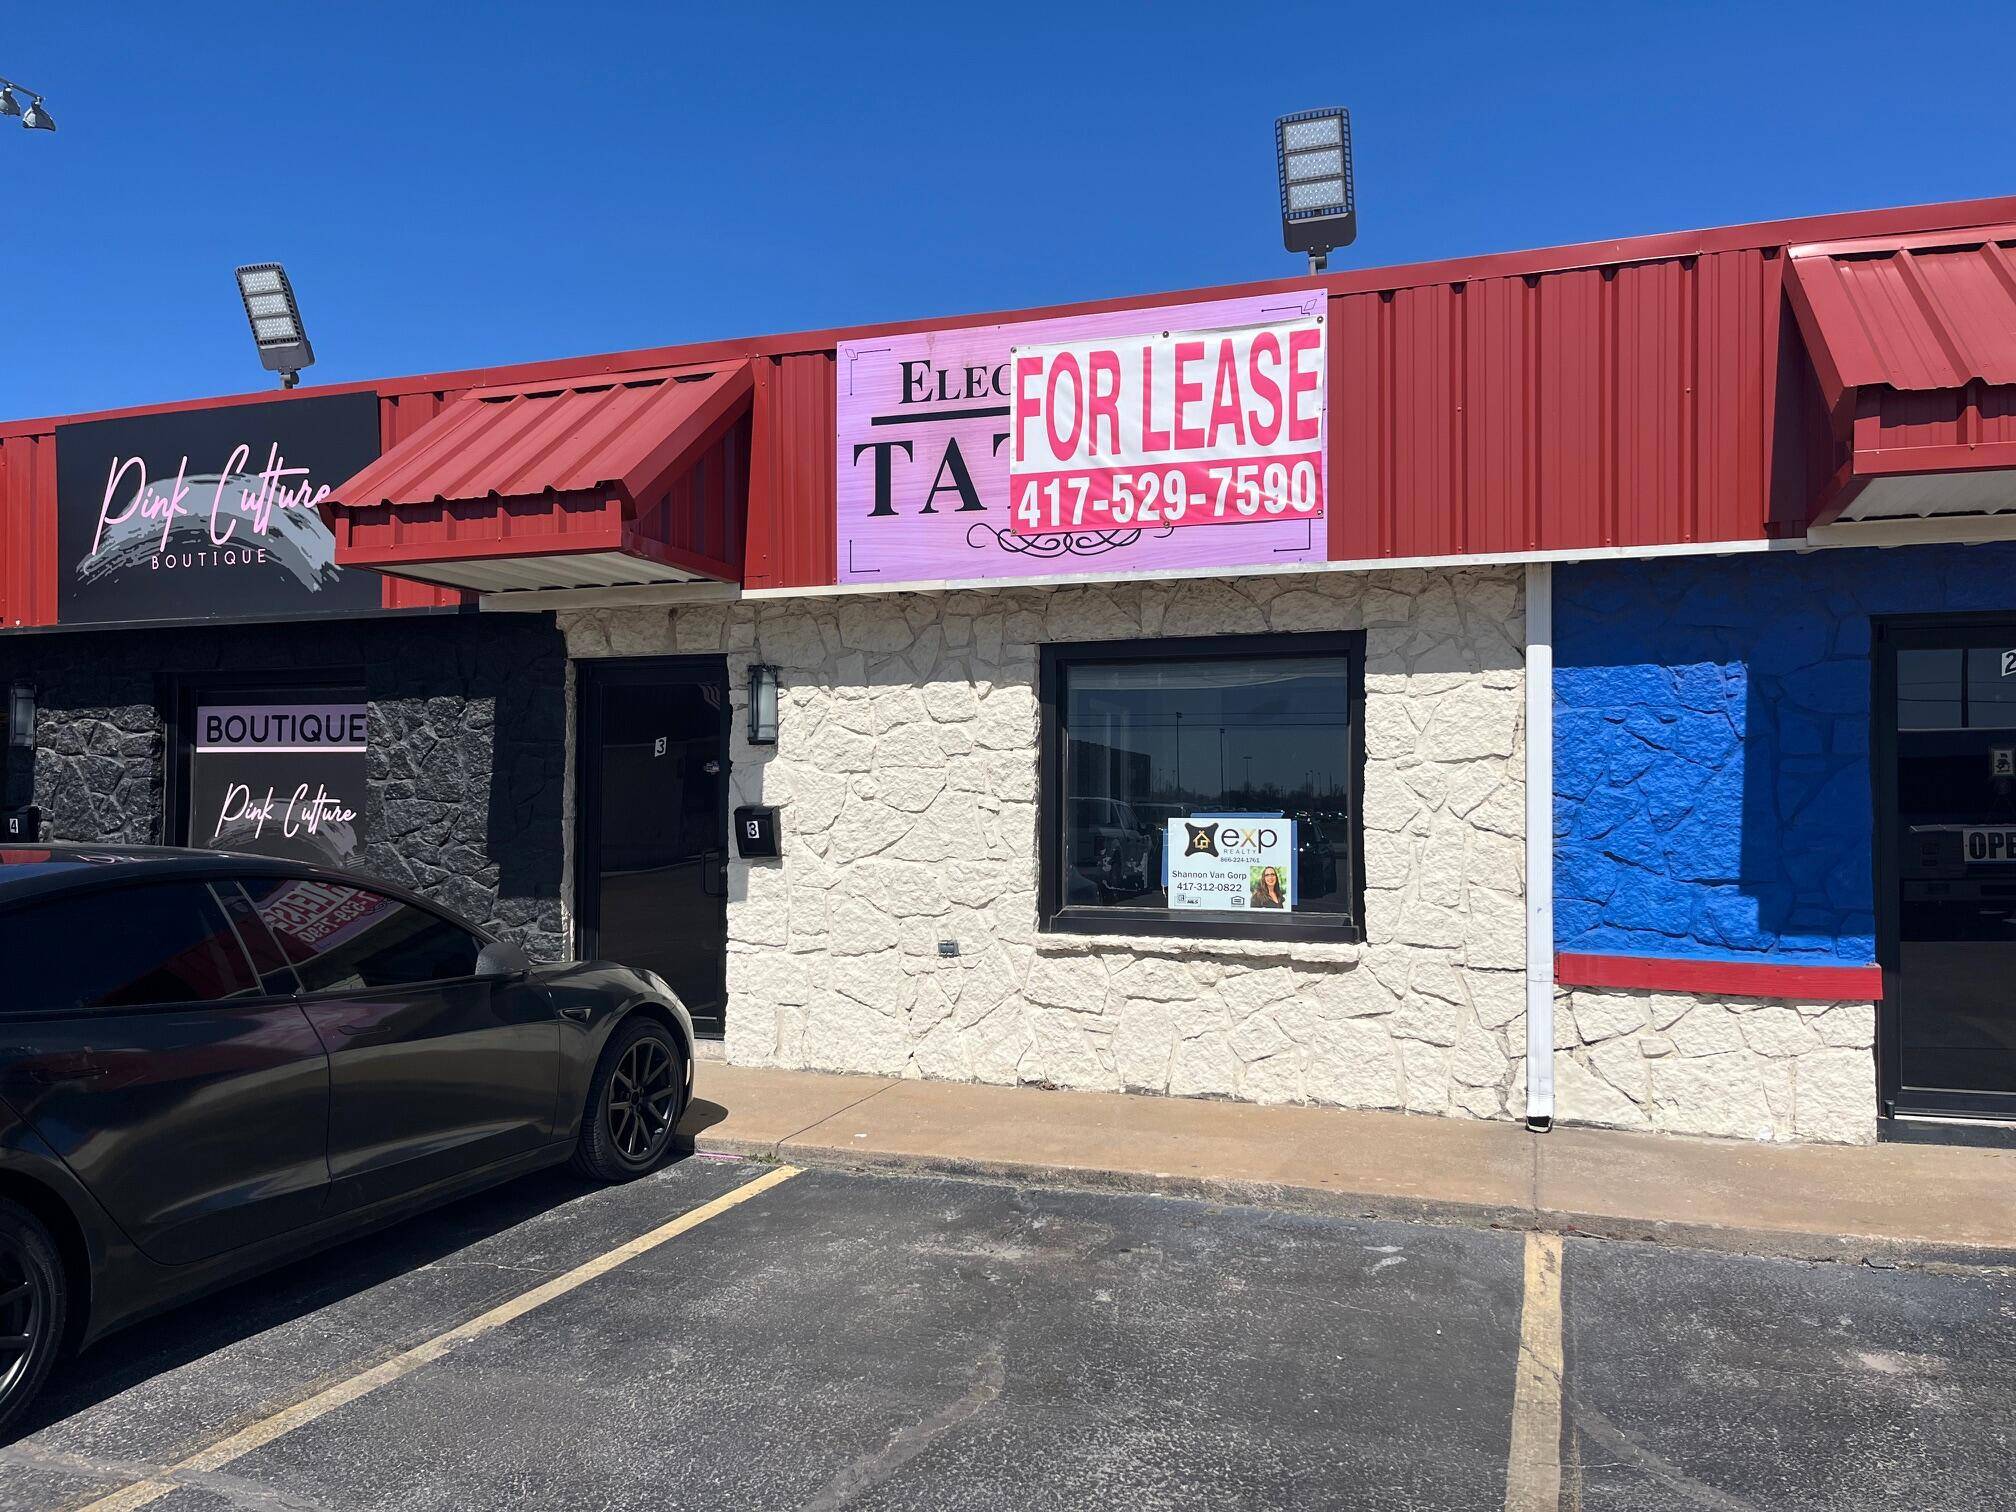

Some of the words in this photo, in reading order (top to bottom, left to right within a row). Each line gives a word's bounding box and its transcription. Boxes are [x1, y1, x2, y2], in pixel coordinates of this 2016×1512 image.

[1016, 349, 1122, 462] FOR
[1142, 328, 1322, 452] LEASE
[91, 455, 190, 556] Pink
[209, 441, 332, 546] Culture
[1017, 460, 1316, 529] 417-529-7590
[151, 548, 267, 570] BOUTIQUE
[206, 714, 366, 744] BOUTIQUE
[656, 738, 665, 755] 3
[214, 783, 273, 838] Pink
[283, 783, 357, 838] Culture
[11, 820, 17, 831] 4
[748, 822, 758, 837] 3
[1221, 828, 1278, 854] exp
[1172, 870, 1208, 879] Shannon
[1210, 871, 1225, 879] Van
[1227, 871, 1247, 880] Gorp
[1176, 882, 1242, 892] 417-312-0822
